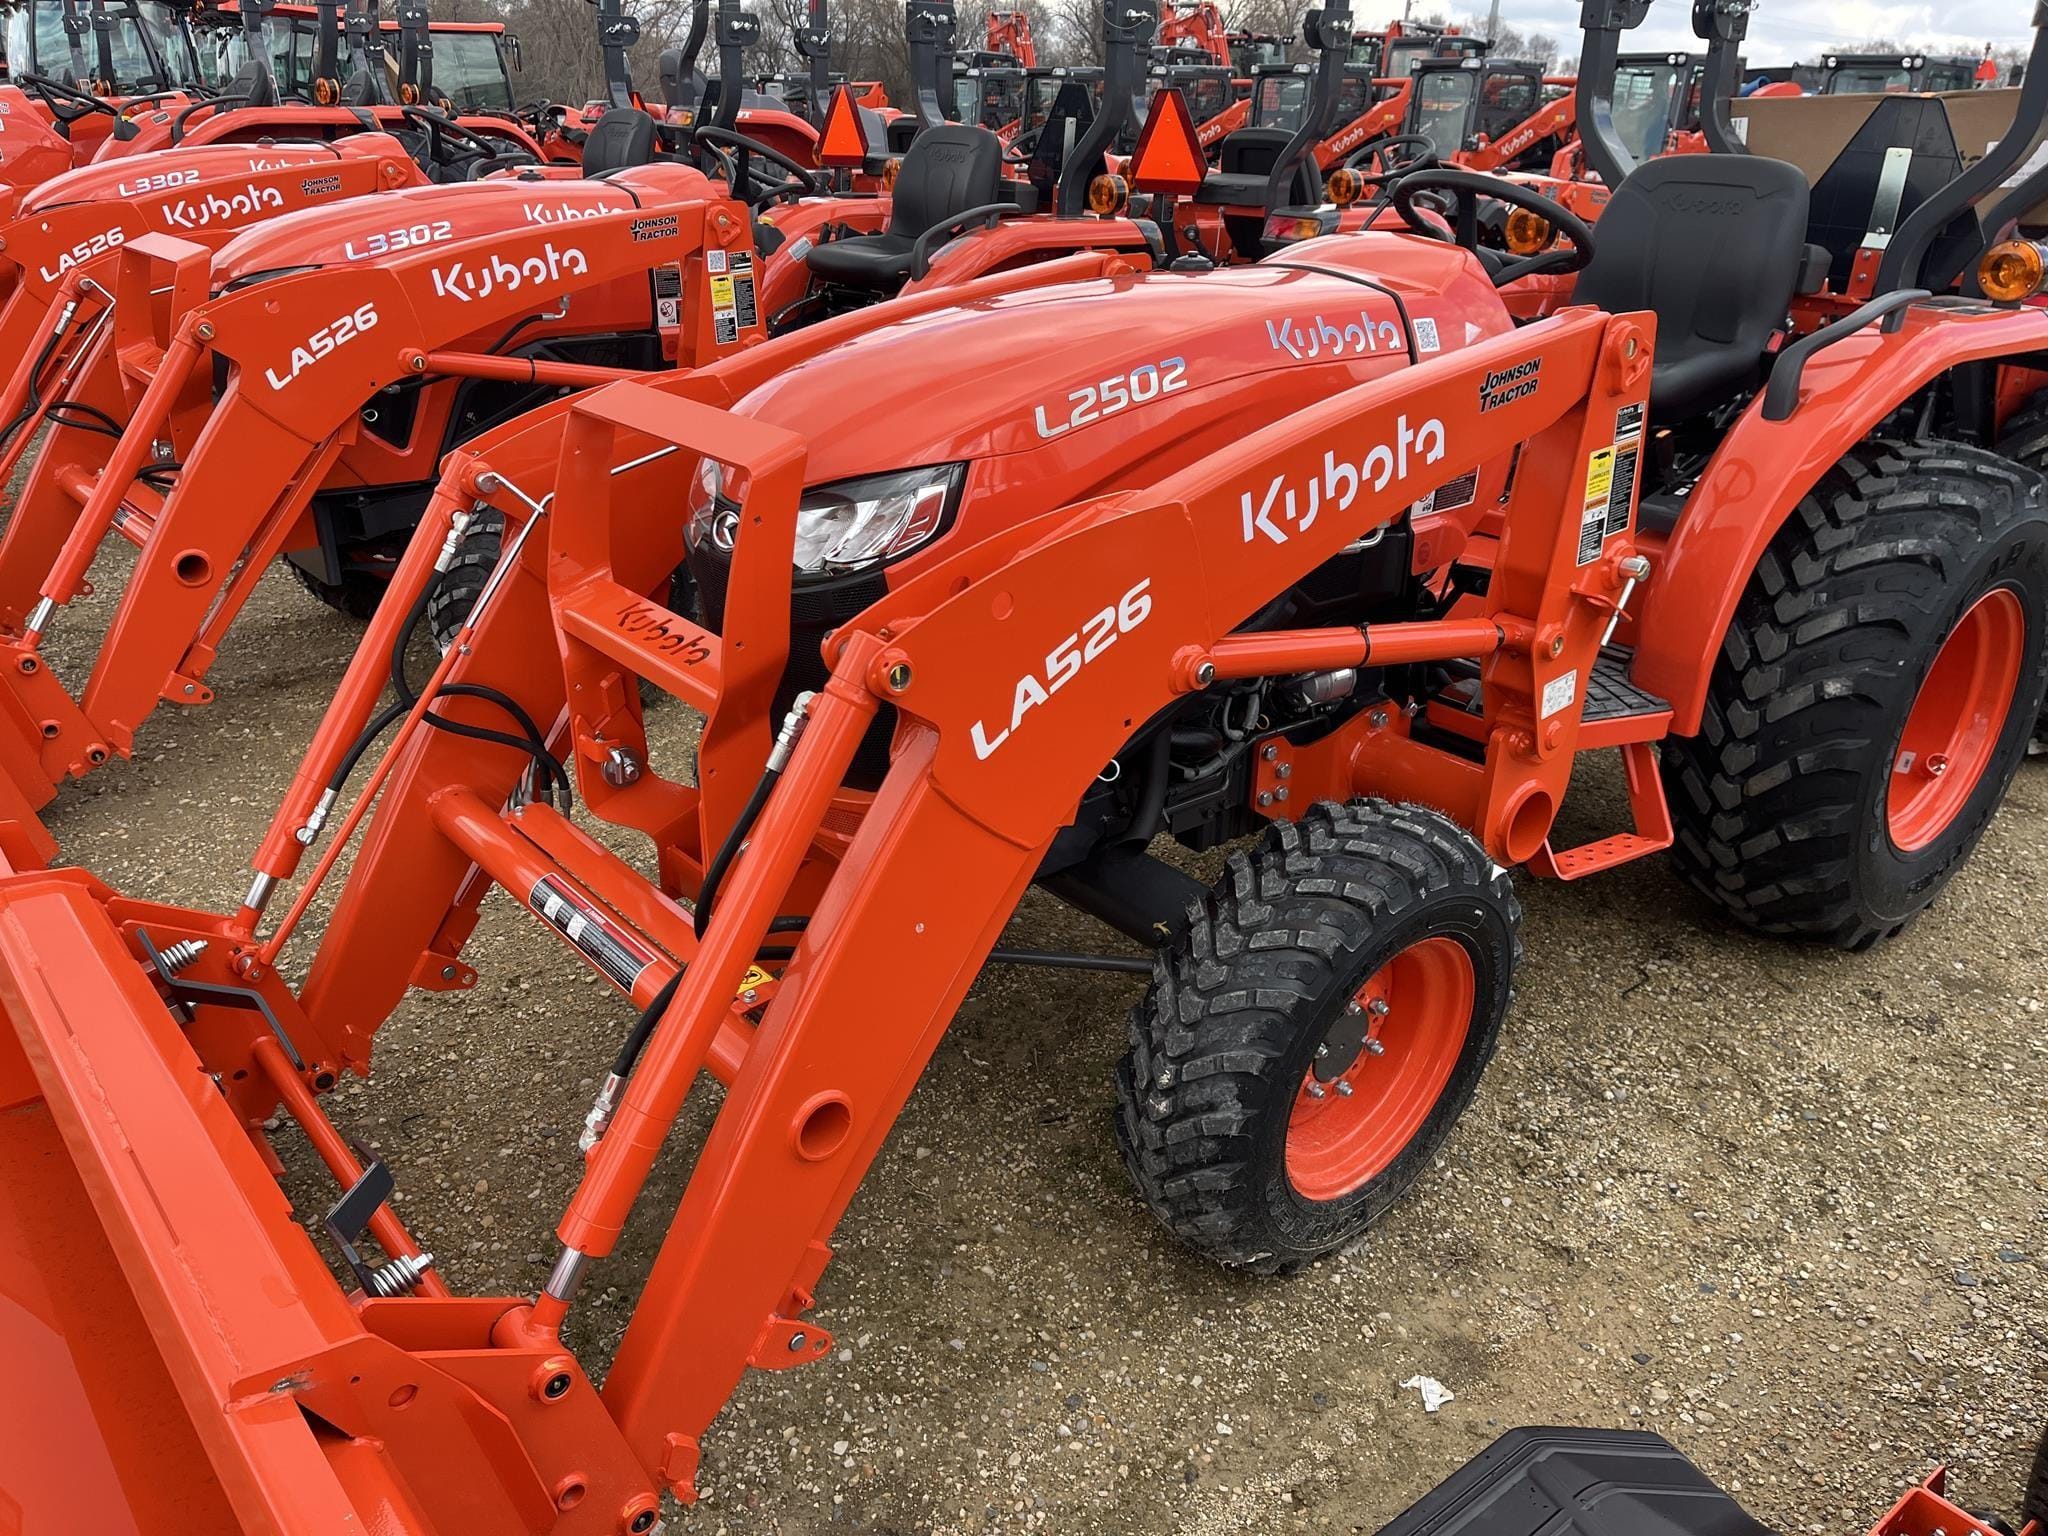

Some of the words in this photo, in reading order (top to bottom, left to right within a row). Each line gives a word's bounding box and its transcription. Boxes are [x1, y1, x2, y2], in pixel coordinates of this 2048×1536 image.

[1331, 127, 1364, 152] Kubota
[1501, 128, 1534, 155] Kubota
[118, 169, 201, 198] L3302
[301, 175, 340, 188] JOHNSON
[303, 184, 341, 196] TRACTOR
[162, 183, 284, 228] Kubota
[630, 215, 678, 231] JOHNSON
[39, 226, 125, 283] LA526
[345, 220, 454, 261] L3302
[631, 227, 678, 241] TRACTOR
[431, 242, 589, 302] Kubota
[264, 301, 379, 391] LA526
[1265, 311, 1401, 360] Kubota
[1479, 357, 1541, 393] JOHNSON
[1480, 378, 1538, 413] TRACTOR
[1034, 356, 1188, 439] L2502
[1241, 414, 1445, 545] Kubota
[616, 601, 711, 666] Kubota
[970, 576, 1152, 761] LA526
